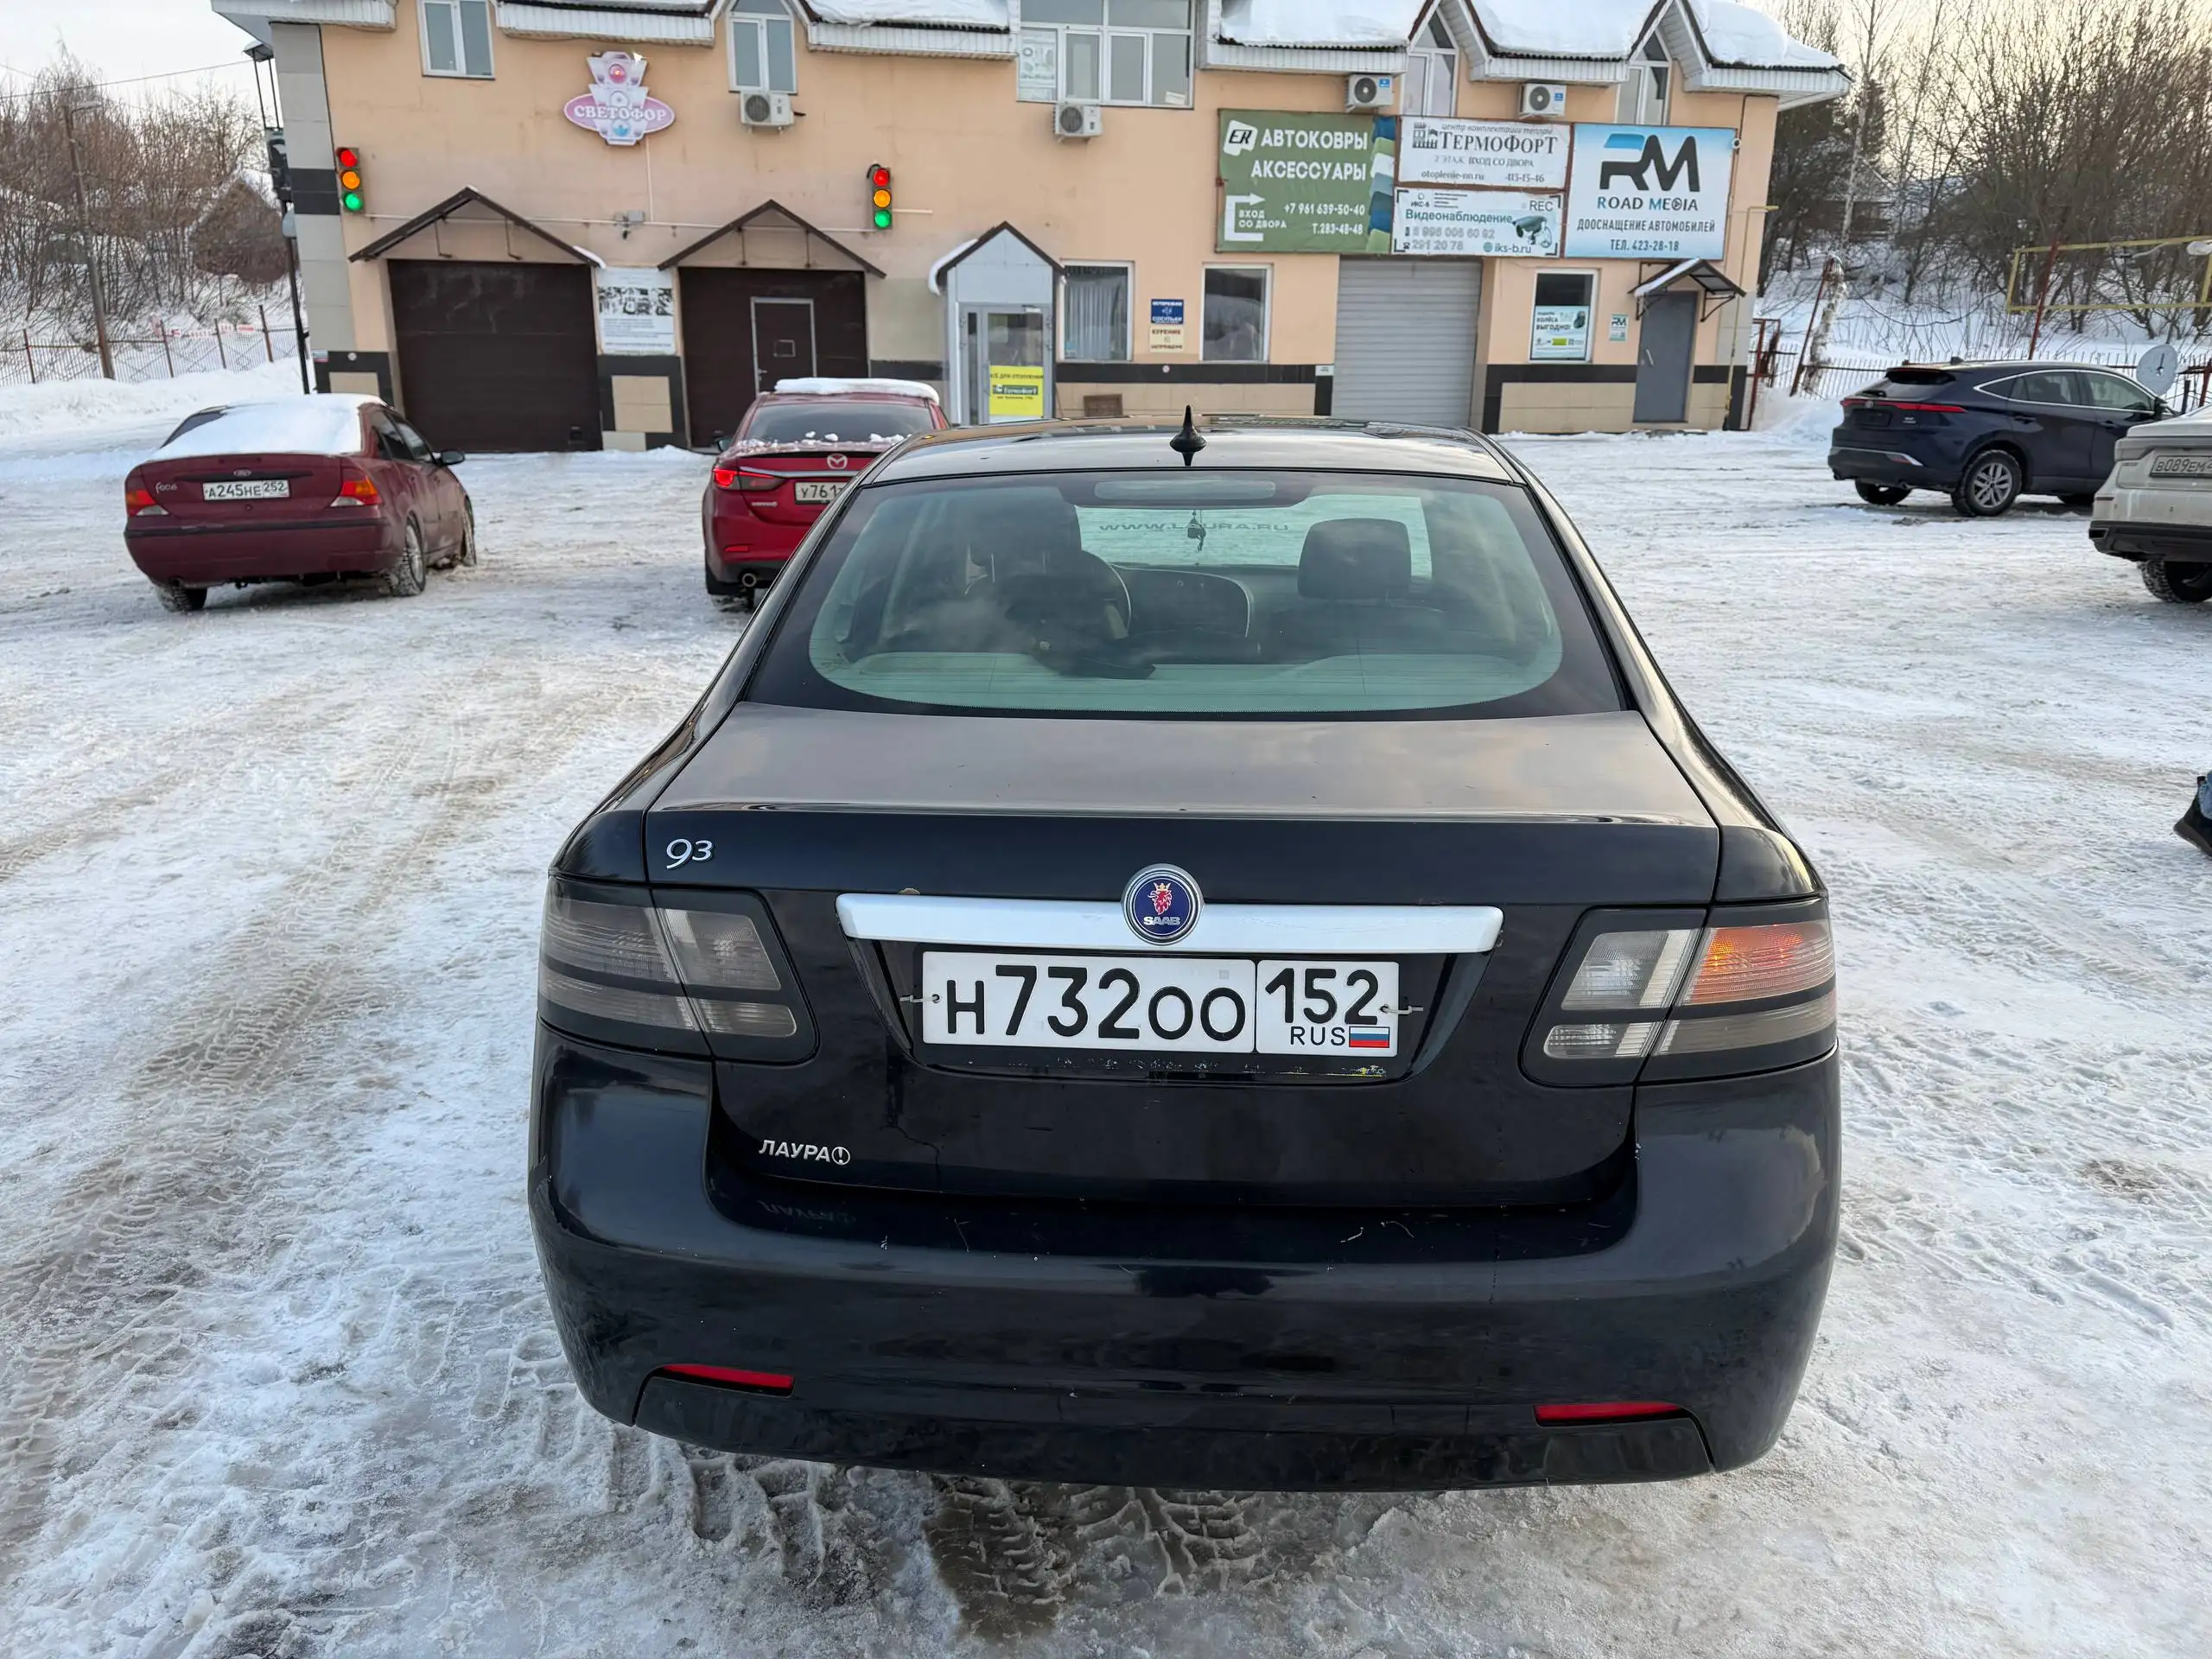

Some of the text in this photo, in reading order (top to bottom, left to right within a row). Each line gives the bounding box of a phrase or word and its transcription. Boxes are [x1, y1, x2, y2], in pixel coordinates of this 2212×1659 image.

[573, 105, 666, 121] СВЕТОФОР
[1261, 129, 1368, 149] АВТОКОВРЫ
[1468, 156, 1491, 167] ВХОД
[1506, 158, 1534, 168] ДВОРА
[1599, 133, 1700, 192] RM
[1251, 160, 1366, 181] АКСЕССУАРЫ
[1284, 203, 1365, 216] +7 961 639-50-40
[1529, 200, 1554, 213] REC
[1598, 196, 1698, 211] ROAD MEDIA
[1238, 209, 1265, 219] ВХОД
[1405, 209, 1513, 225] Видеонаблюдение
[1238, 219, 1287, 229] СО ДВОРА
[1577, 218, 1715, 232] ДООСНАЩЕНИЕ АВТОМОБИЛЕЙ
[1433, 240, 1448, 251] 20
[1494, 242, 1532, 254] iks-b.ru
[1611, 238, 1679, 251] ТЕЛ. 423-28-18
[208, 484, 260, 498] А245НЕ
[263, 482, 285, 493] 252
[1143, 916, 1181, 925] SAAB
[947, 963, 1379, 1042] Н732ОО 152
[1289, 1025, 1346, 1047] RUS
[759, 1139, 832, 1163] ЛАУРА
